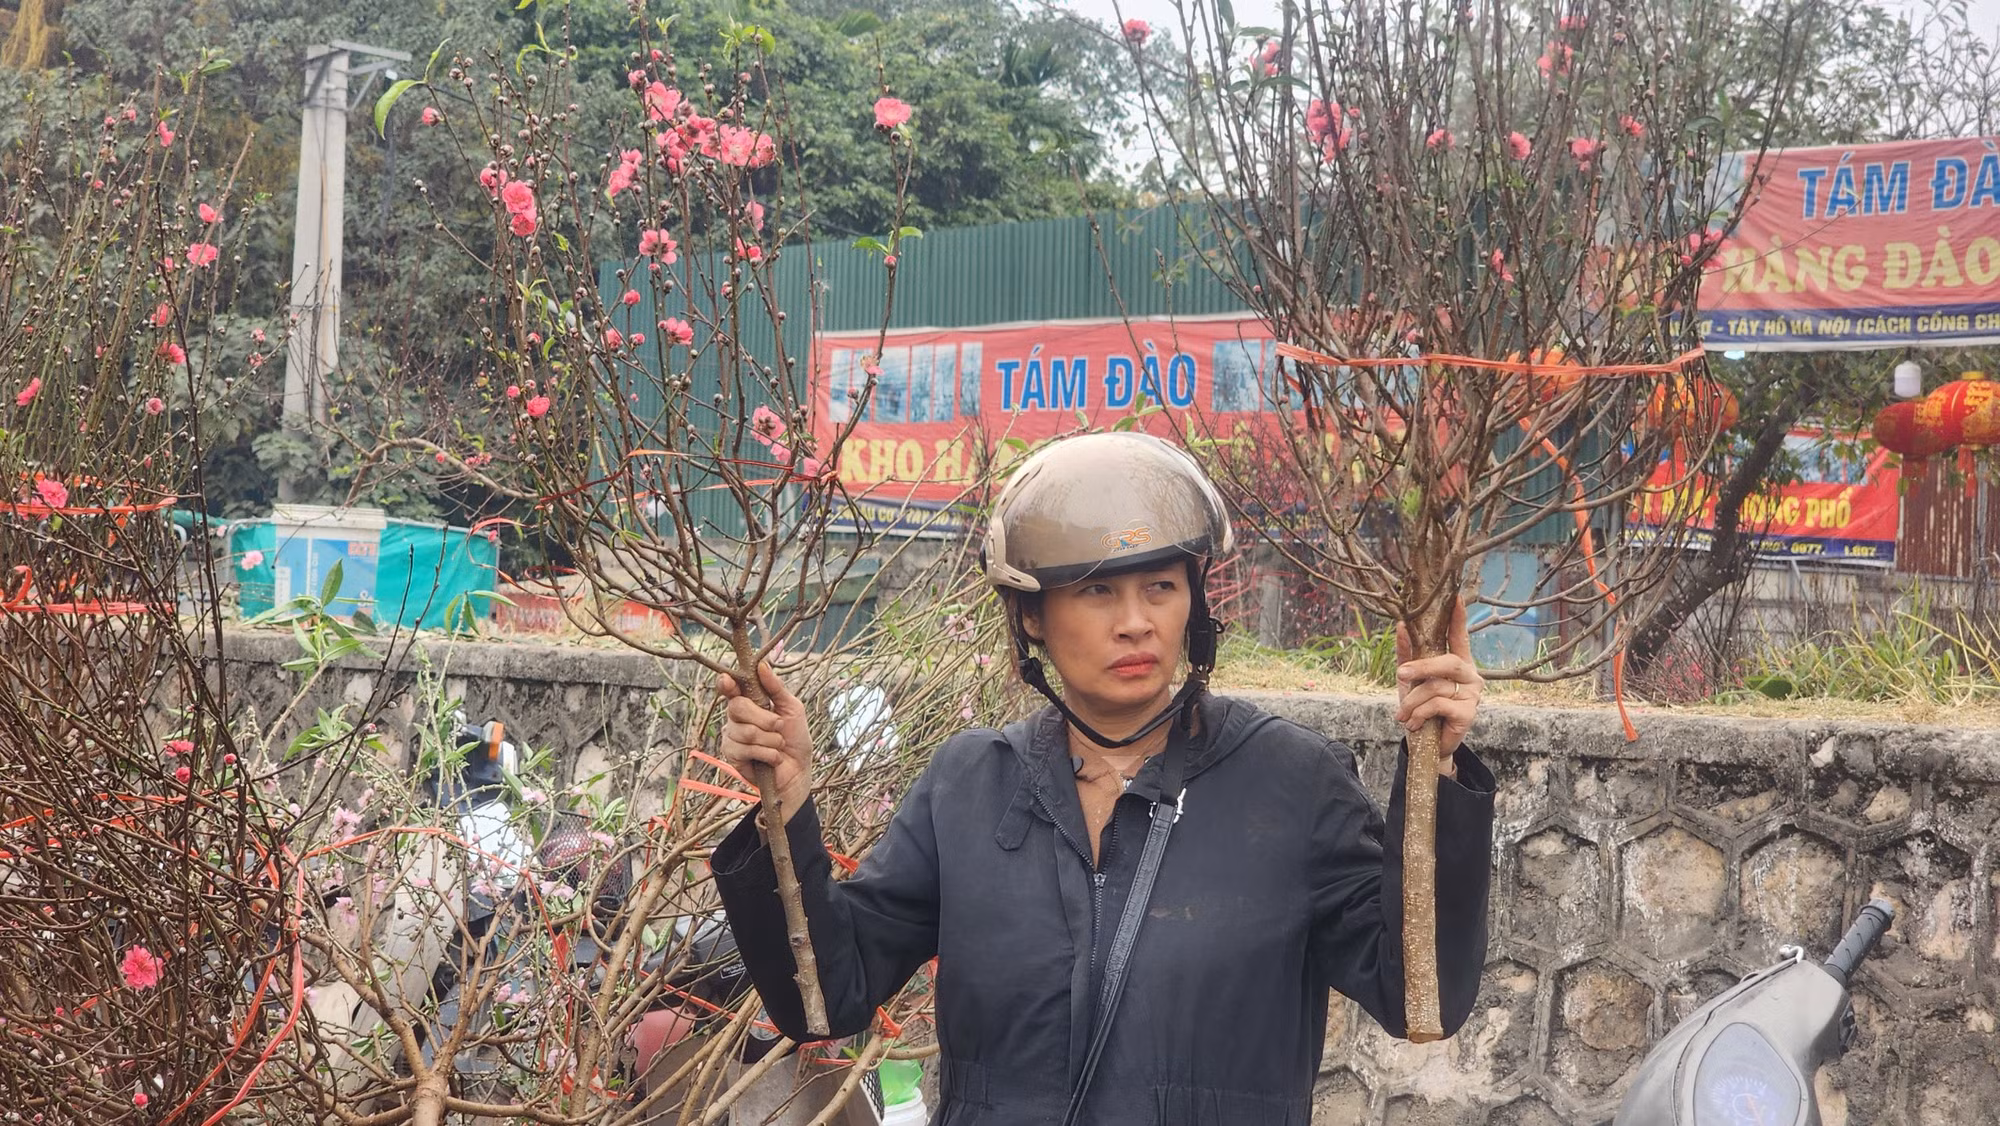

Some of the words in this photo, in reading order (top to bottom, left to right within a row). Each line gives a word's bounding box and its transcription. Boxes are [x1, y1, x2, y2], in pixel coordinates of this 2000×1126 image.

[1798, 152, 1911, 220] TÁM
[1721, 235, 1869, 294] HÀNG
[1882, 225, 2000, 289] ĐÀO
[1727, 316, 1760, 336] TÂY
[1817, 316, 1851, 338] NỘI
[996, 344, 1089, 412] TÁM
[1104, 338, 1197, 408] ĐÀO
[840, 438, 924, 483] KHO
[1804, 486, 1853, 528] PHỐ
